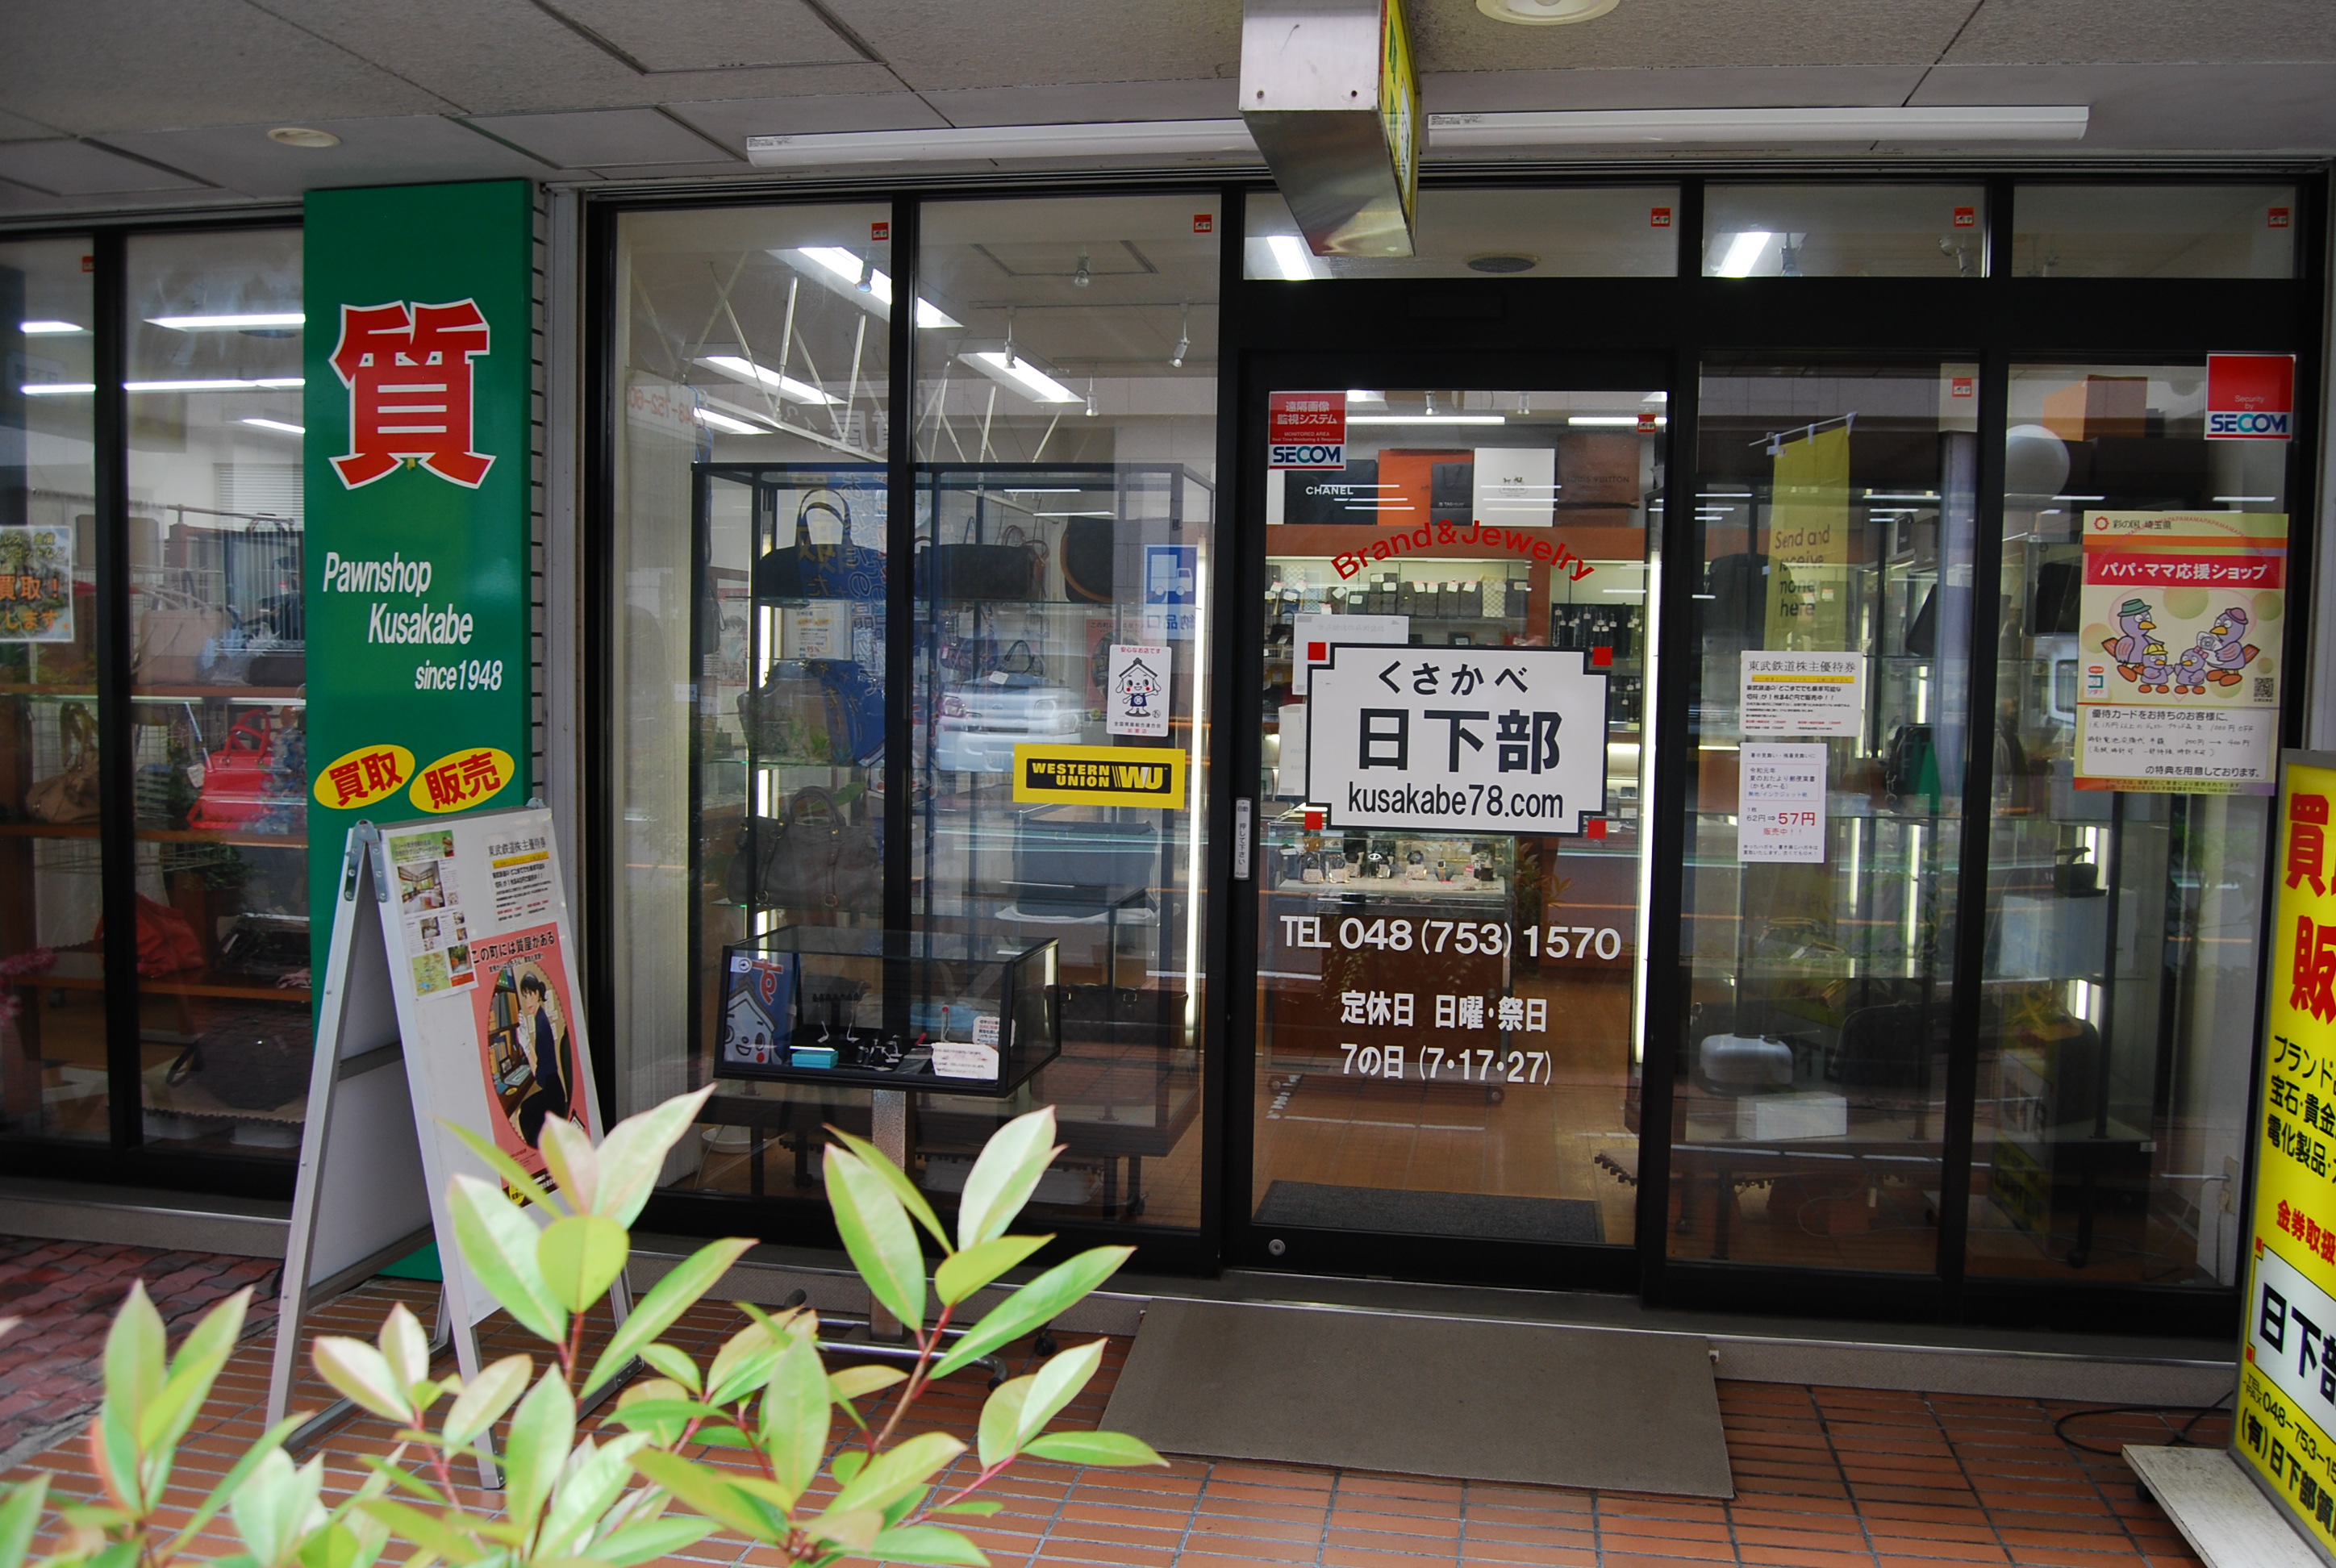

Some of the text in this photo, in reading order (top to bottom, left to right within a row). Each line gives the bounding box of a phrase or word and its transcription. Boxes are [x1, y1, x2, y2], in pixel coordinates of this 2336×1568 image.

[328, 298, 496, 490] 質
[1286, 401, 1329, 412] 遠隔画像
[2235, 395, 2264, 403] Security
[1277, 414, 1337, 425] 監視システム
[2211, 414, 2288, 433] SECOM
[1273, 445, 1341, 464] SECOM
[1305, 486, 1354, 496] CHANEL
[2113, 519, 2141, 529] 彩の国
[1331, 519, 1595, 582] Brand&Jewelry
[323, 552, 432, 597] Pawnshop
[2100, 562, 2267, 581] パパ・ママ応援ショップ
[368, 603, 473, 644] Kusakabe
[1780, 598, 1816, 617] here
[1120, 646, 1161, 654] 安心なお店です
[1379, 661, 1529, 696] くさかべ
[1748, 661, 1856, 673] 東武鉄道株主優待券
[2092, 709, 2229, 722] 優待カードをお持ちのお客様に、
[1358, 707, 1563, 775] 日下部
[328, 752, 503, 810] 買取 販売
[1032, 762, 1110, 776] WESTERN
[1056, 775, 1110, 788] UNION
[2145, 765, 2260, 778] の特典を用意しております。
[1348, 781, 1564, 819] kusakabe78.com
[1746, 811, 1816, 826] 62円 57円
[1238, 823, 1247, 865] 押して下さい
[2285, 792, 2336, 898] 買
[472, 931, 555, 964] この町には質屋がある
[1279, 915, 1332, 949] TEL
[1341, 990, 1547, 1032] 定休日 日曜・祭日
[1341, 1043, 1404, 1080] 7の日
[2274, 1035, 2336, 1095] ブランド
[2267, 1113, 2336, 1184] 電化製品・
[2276, 1199, 2336, 1266] 金券取扱
[2241, 1407, 2336, 1541] (有)日下部質
